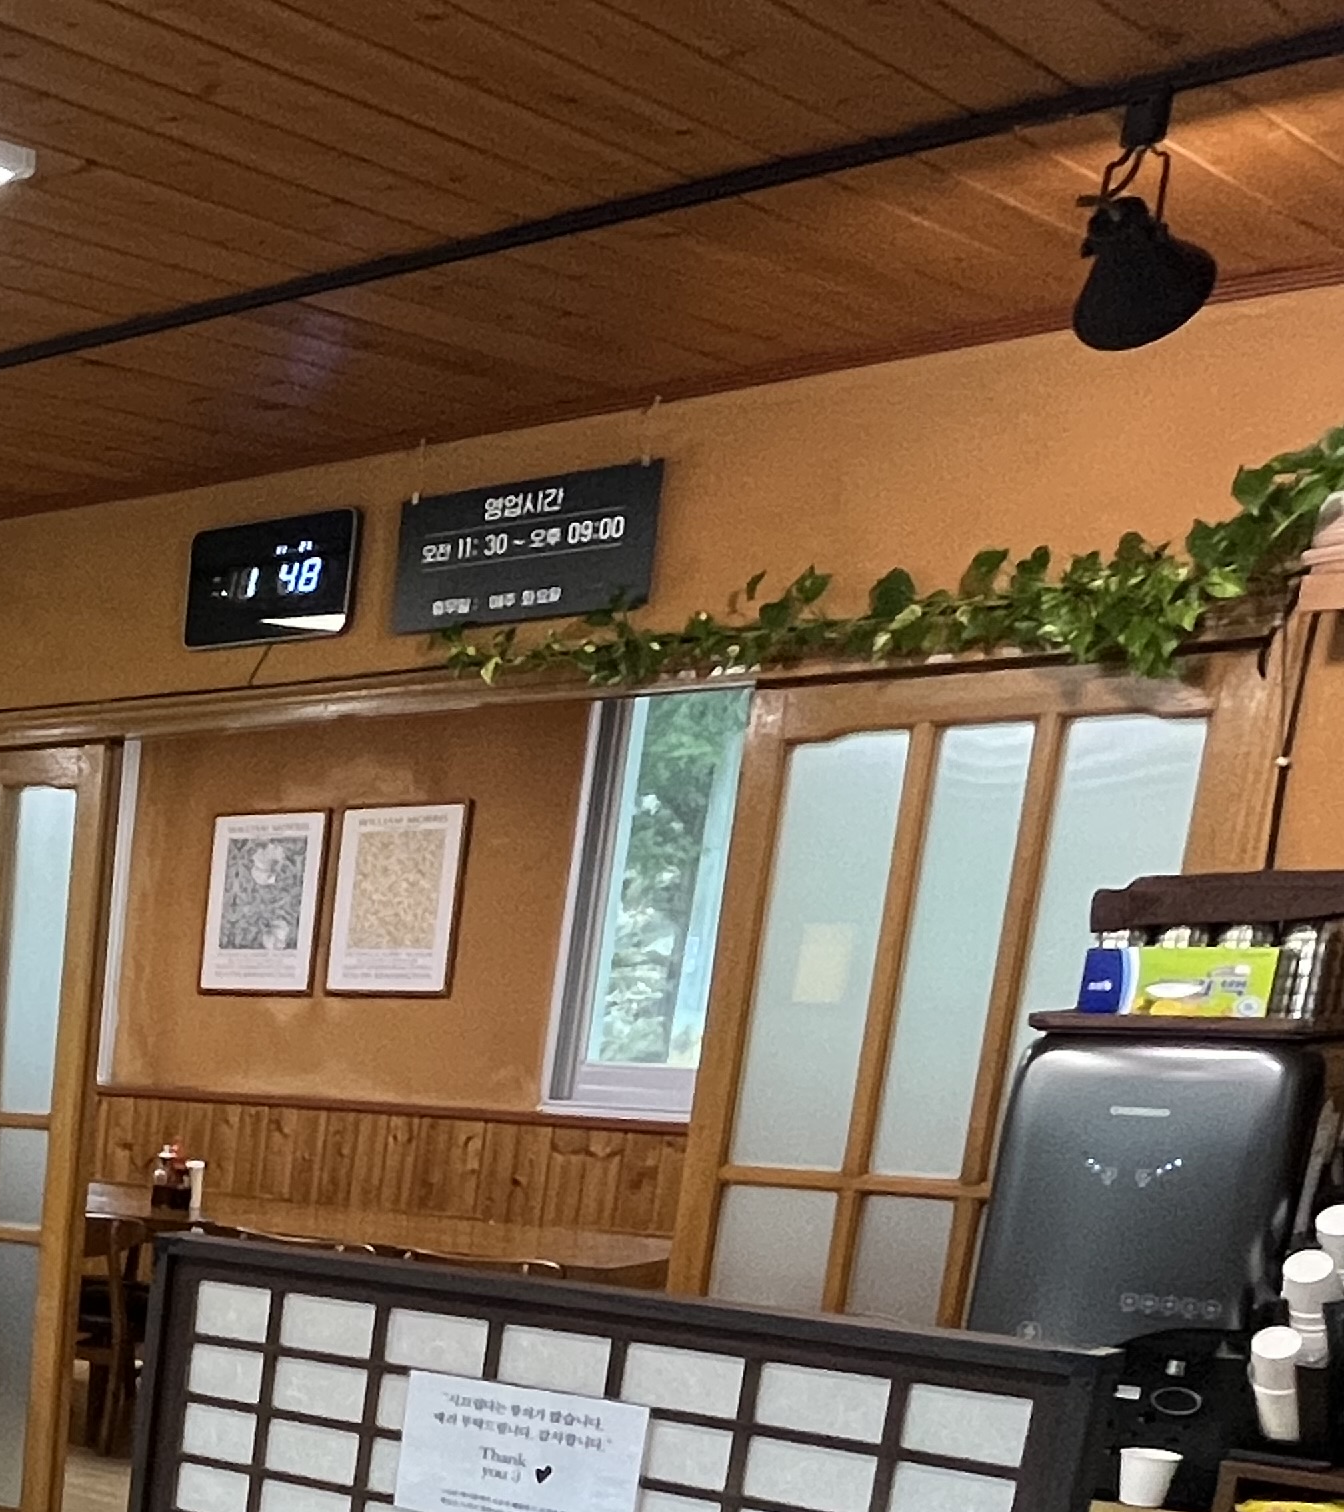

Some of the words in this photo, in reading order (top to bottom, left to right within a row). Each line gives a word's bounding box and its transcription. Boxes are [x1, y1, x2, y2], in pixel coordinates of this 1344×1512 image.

[484, 486, 564, 521] 영업시간
[421, 543, 452, 564] 오전
[529, 527, 562, 549] 오후
[567, 516, 625, 544] 09:00
[478, 1445, 527, 1467] Thank
[480, 1466, 507, 1481] you
